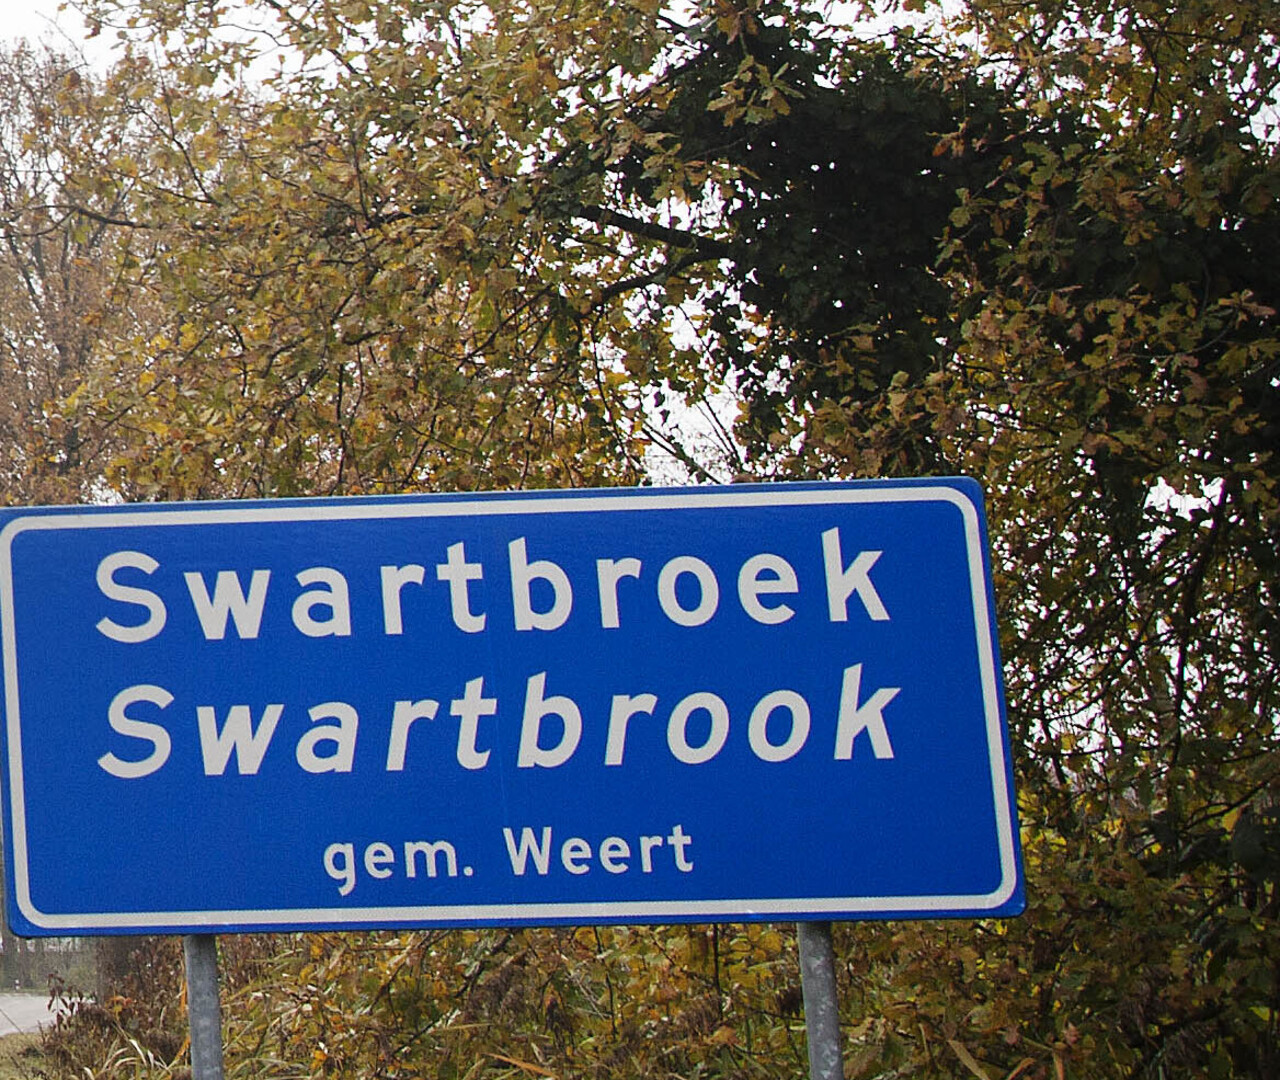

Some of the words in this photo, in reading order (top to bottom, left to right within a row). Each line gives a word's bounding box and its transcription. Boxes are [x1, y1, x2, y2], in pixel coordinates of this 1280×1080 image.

[96, 528, 890, 643] Swartbroek
[98, 664, 900, 778] Swartbrook
[324, 840, 473, 896] gem.
[503, 825, 693, 876] Weert
